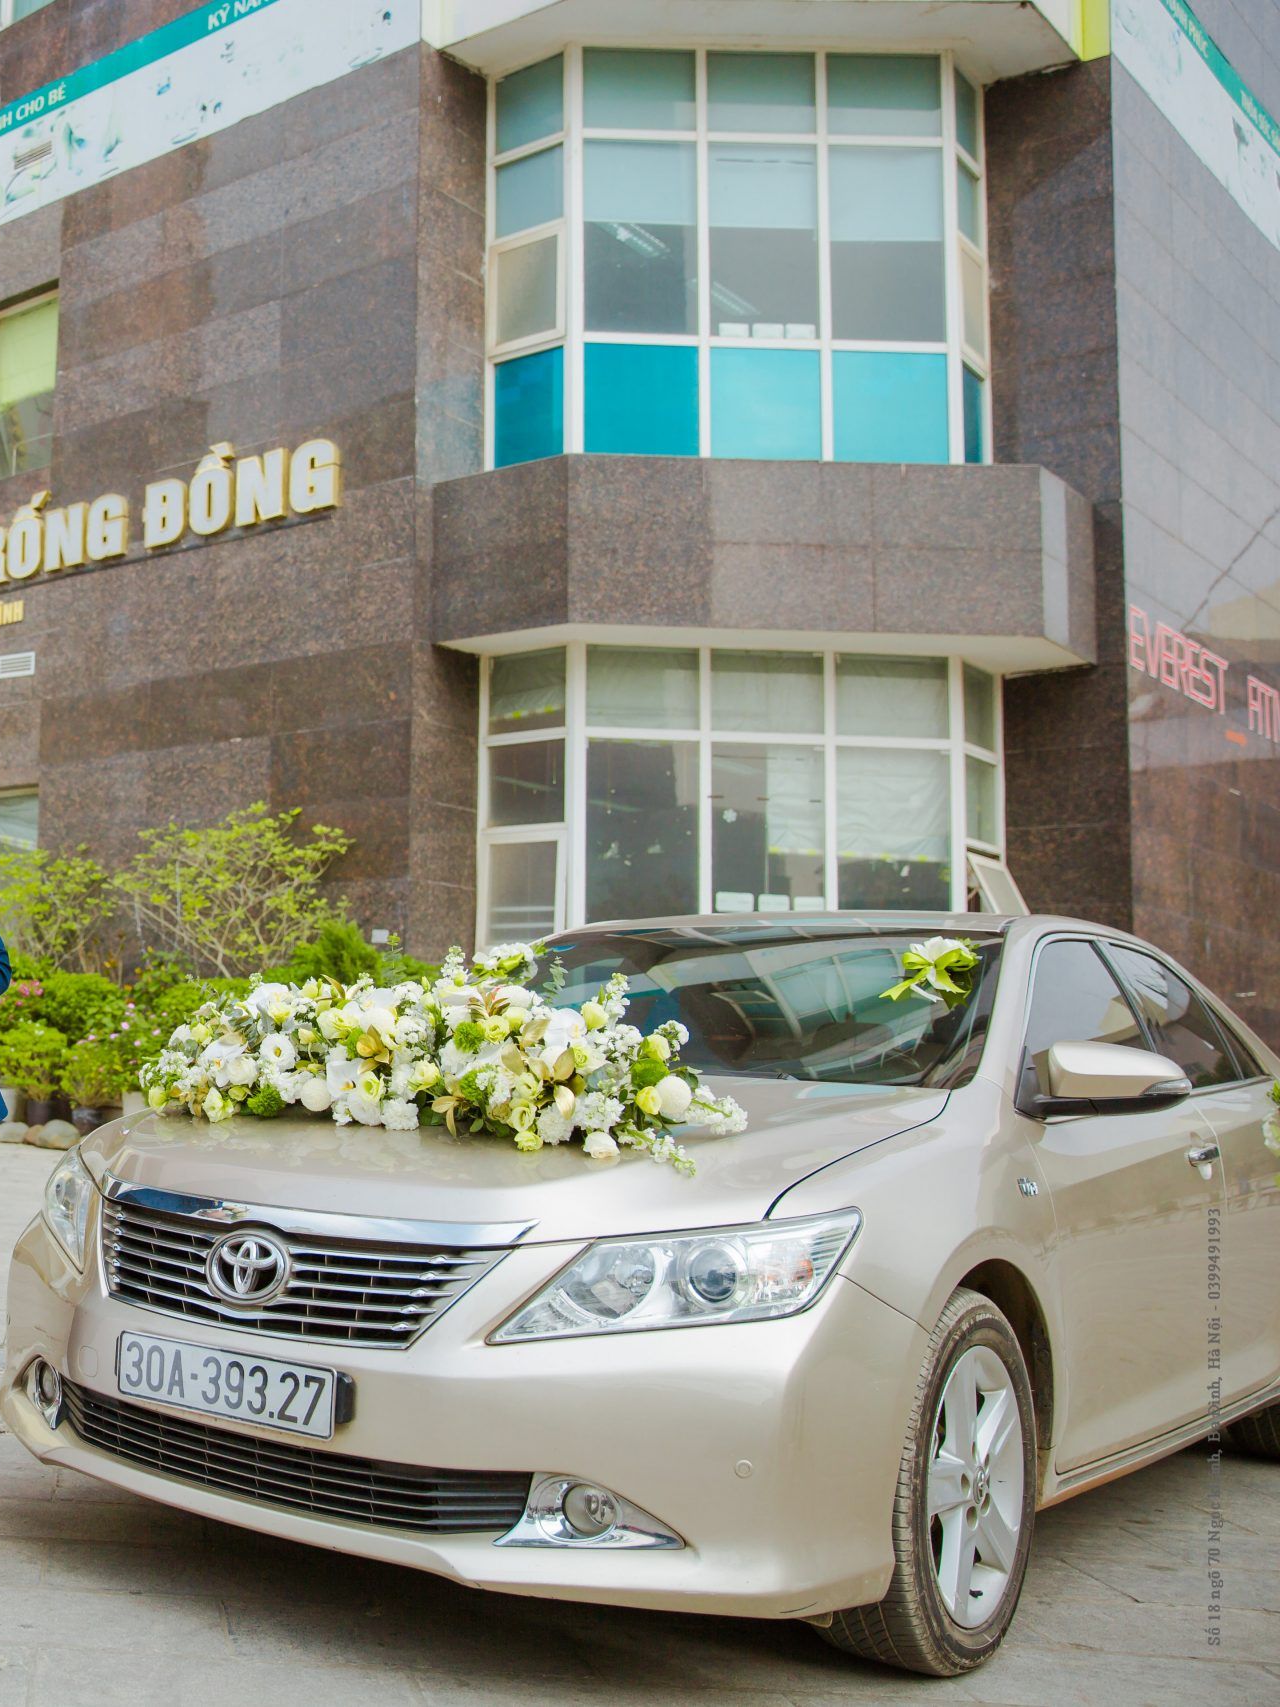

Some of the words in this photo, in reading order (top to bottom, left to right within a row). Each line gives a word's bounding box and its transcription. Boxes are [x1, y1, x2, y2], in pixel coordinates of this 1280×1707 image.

[16, 95, 45, 121] CHO
[48, 81, 66, 106] BÉ
[142, 438, 341, 549] ĐỒNG
[1129, 603, 1229, 716] EVEREST
[125, 1340, 326, 1426] 30A-393.27
